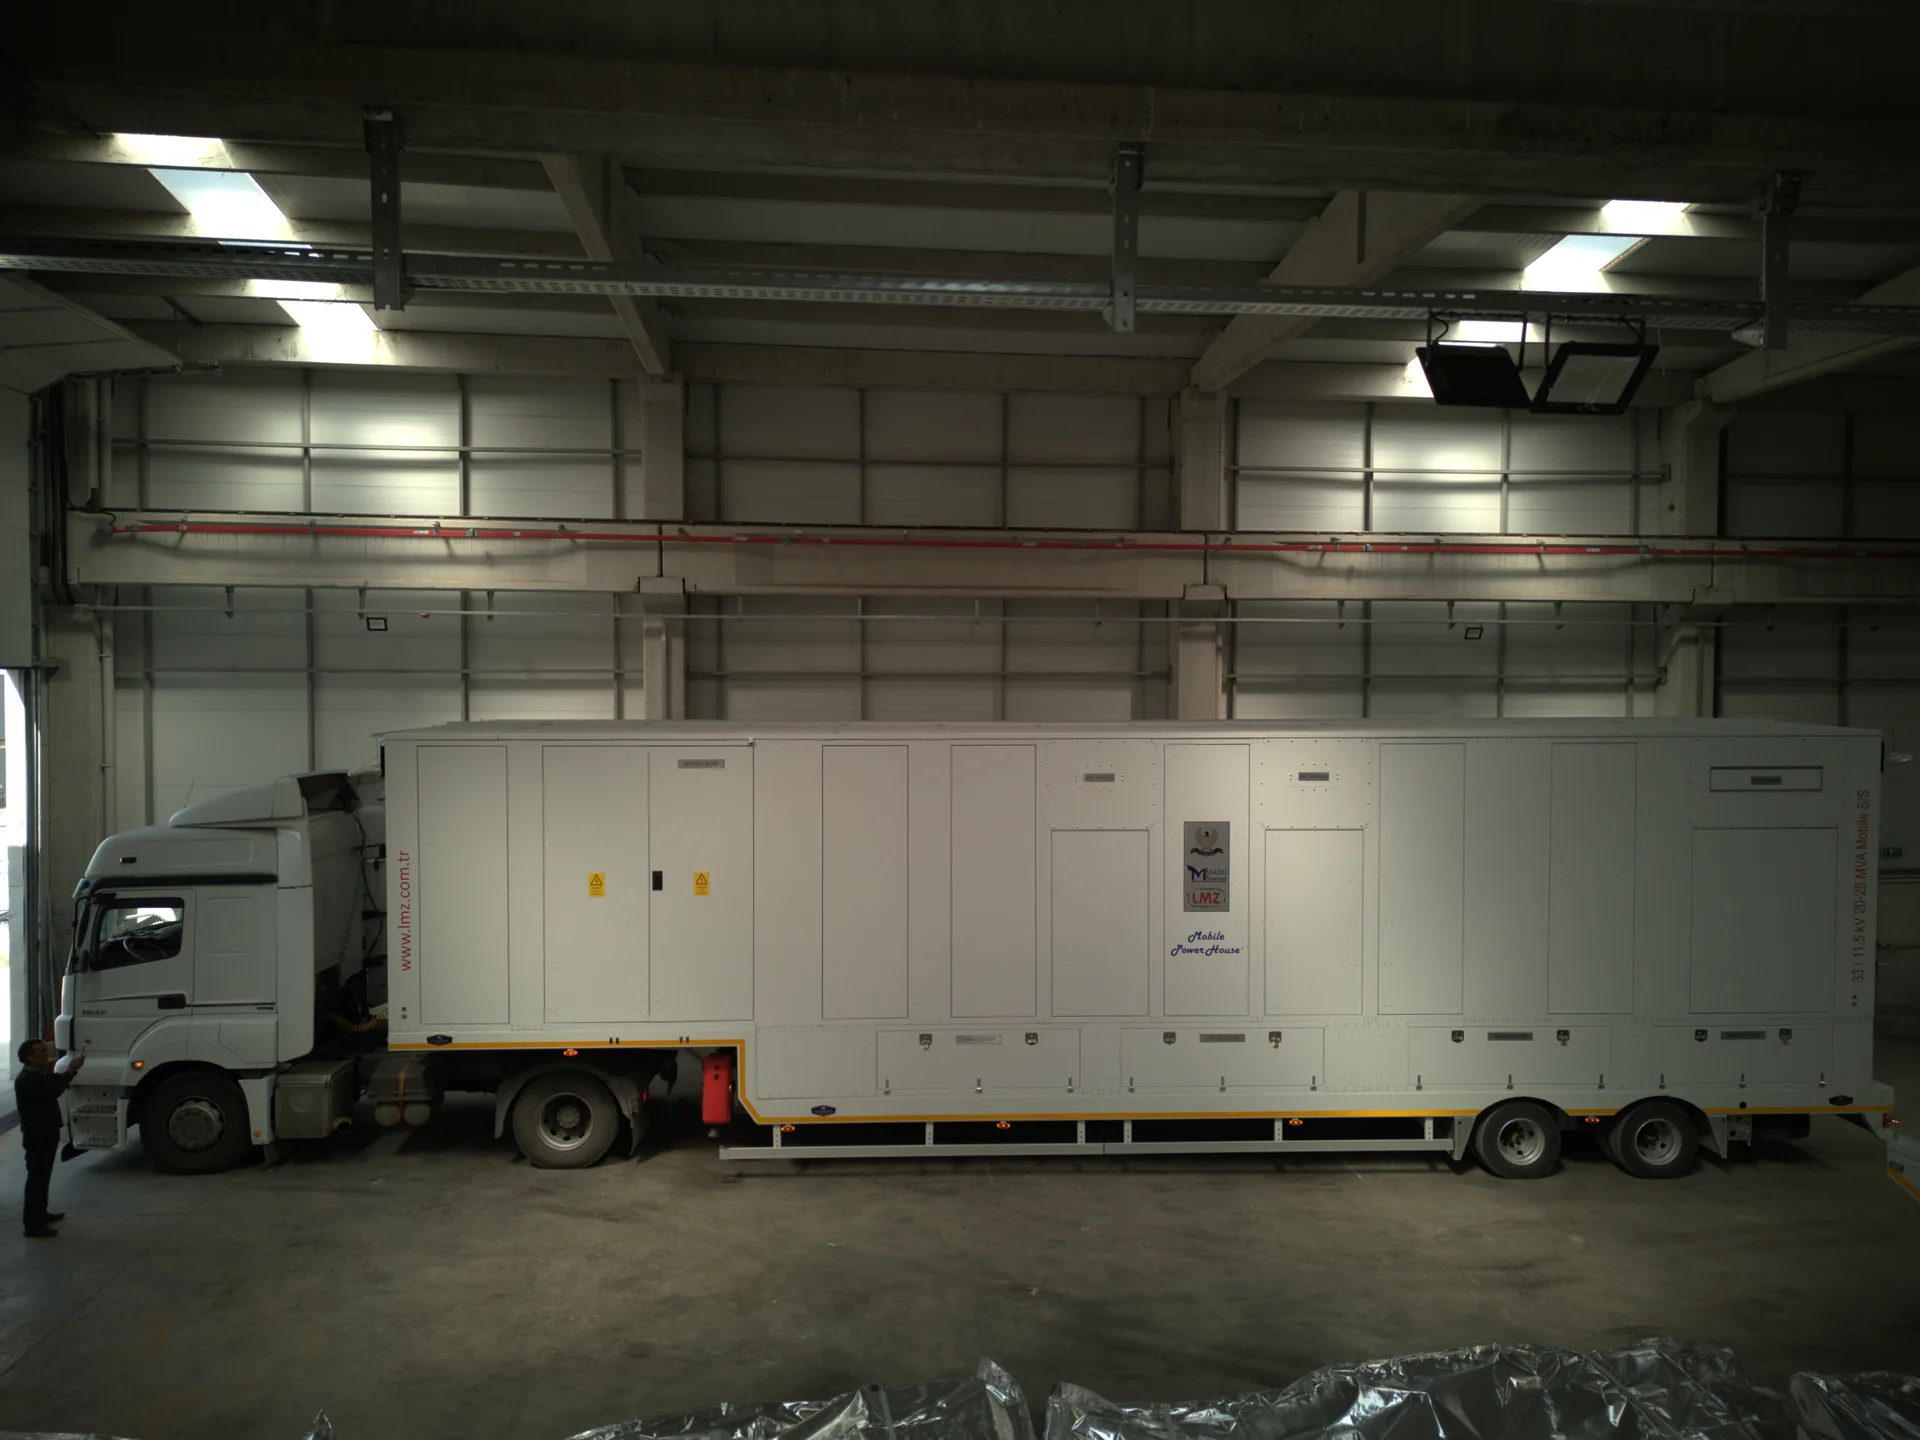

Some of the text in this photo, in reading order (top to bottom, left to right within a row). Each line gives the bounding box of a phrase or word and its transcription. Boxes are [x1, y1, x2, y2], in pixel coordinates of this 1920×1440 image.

[1856, 789, 1870, 810] S/S
[1855, 813, 1869, 850] Mobile
[1855, 852, 1868, 879] MVA
[1192, 891, 1221, 905] LMZ
[1854, 882, 1867, 914] 20-25
[397, 850, 412, 972] www.lmz.com.tr
[1853, 916, 1866, 932] kV
[1187, 930, 1225, 943] Mobile
[1852, 969, 1865, 983] 33
